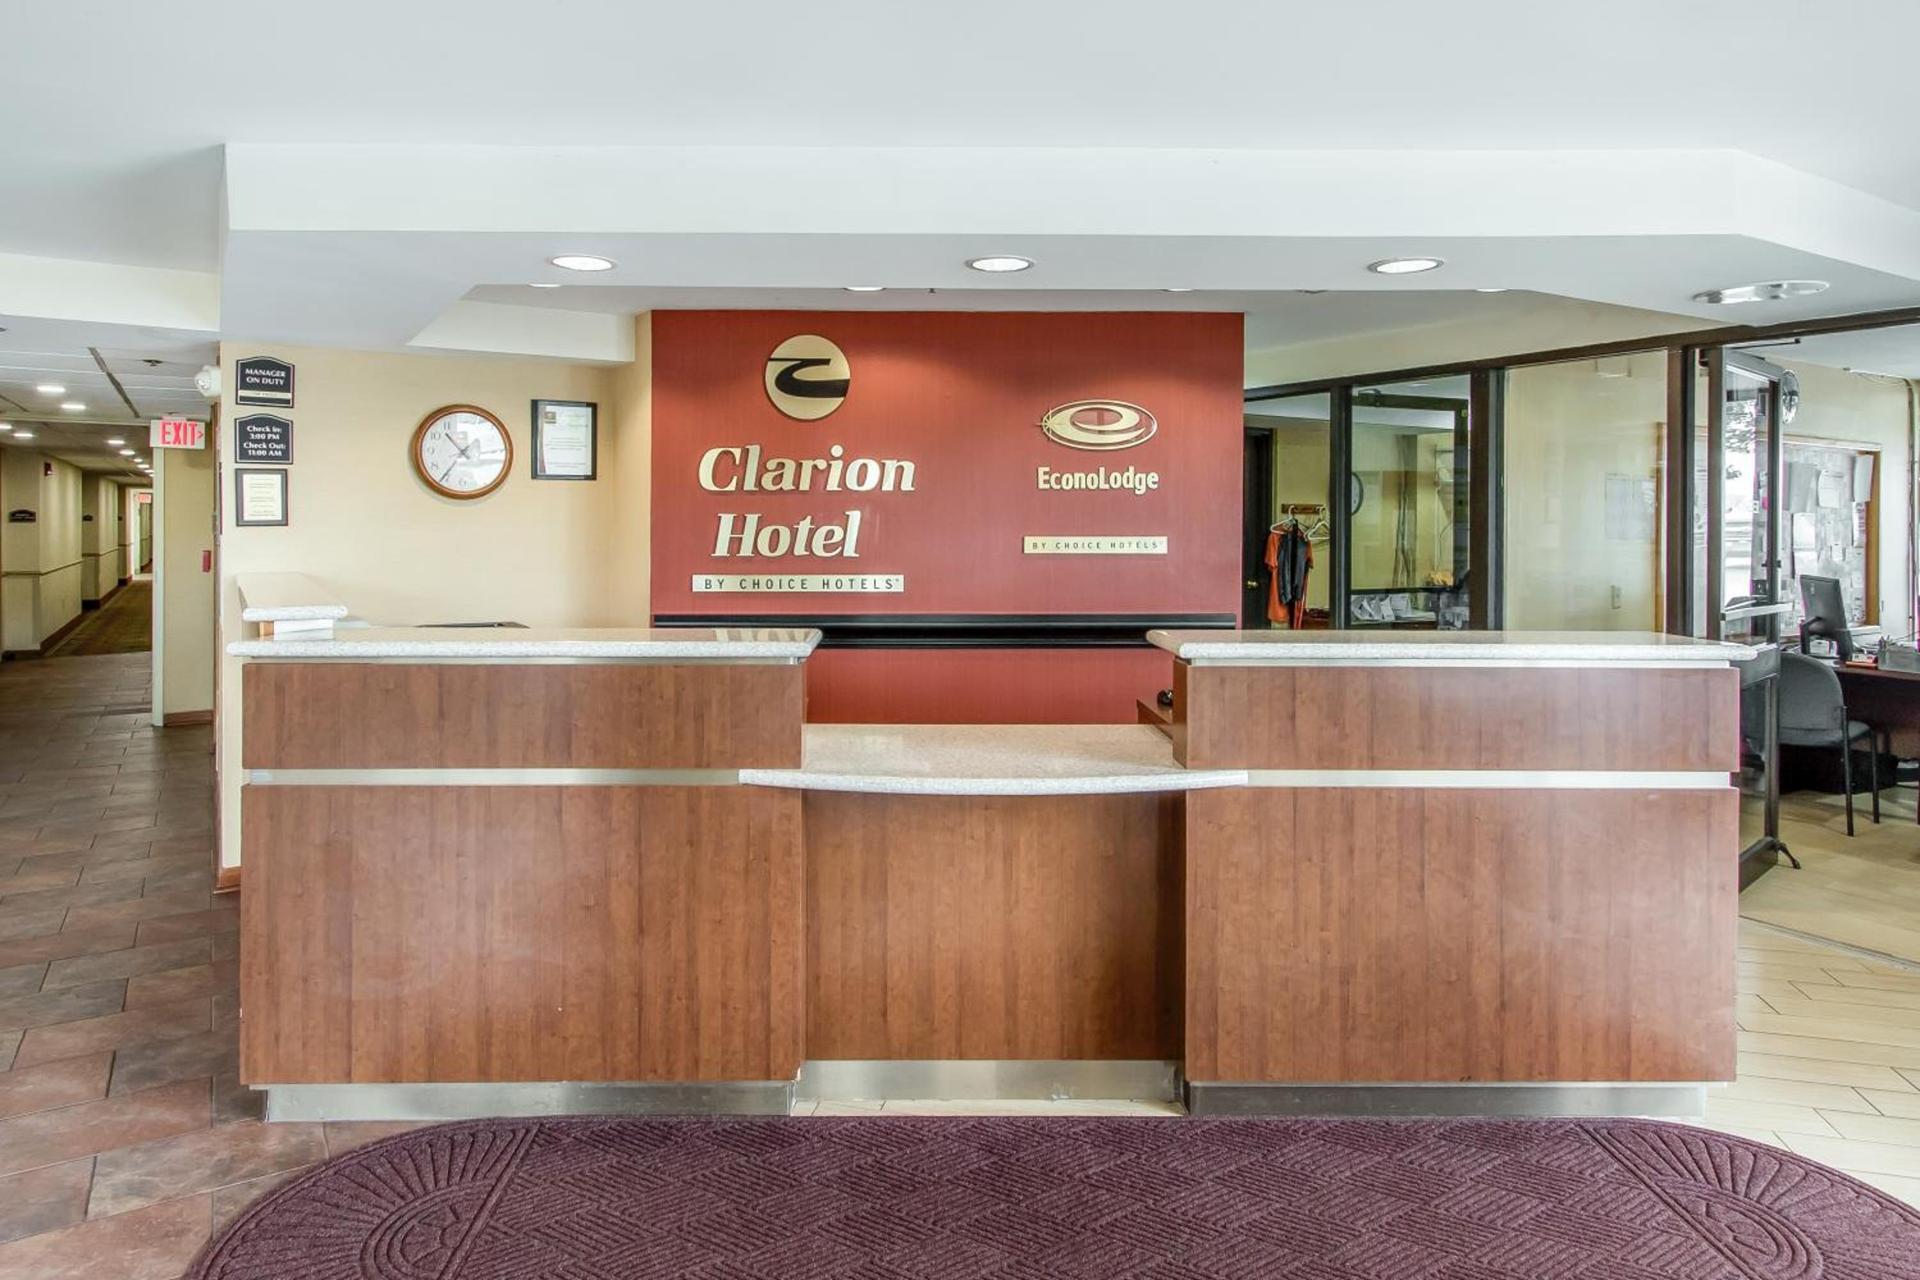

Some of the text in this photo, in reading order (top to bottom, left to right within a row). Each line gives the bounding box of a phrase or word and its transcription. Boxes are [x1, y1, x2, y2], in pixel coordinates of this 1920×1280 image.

[245, 368, 286, 378] MANAGER
[246, 376, 285, 386] ON DUTY
[160, 421, 198, 447] EXIT
[698, 444, 916, 492] Clarion
[1037, 465, 1159, 495] EconoLodge
[710, 510, 862, 558] Hotel
[1032, 541, 1159, 550] BY CHOICE HOTELS
[704, 578, 894, 590] BY CHOICE HOTELS
